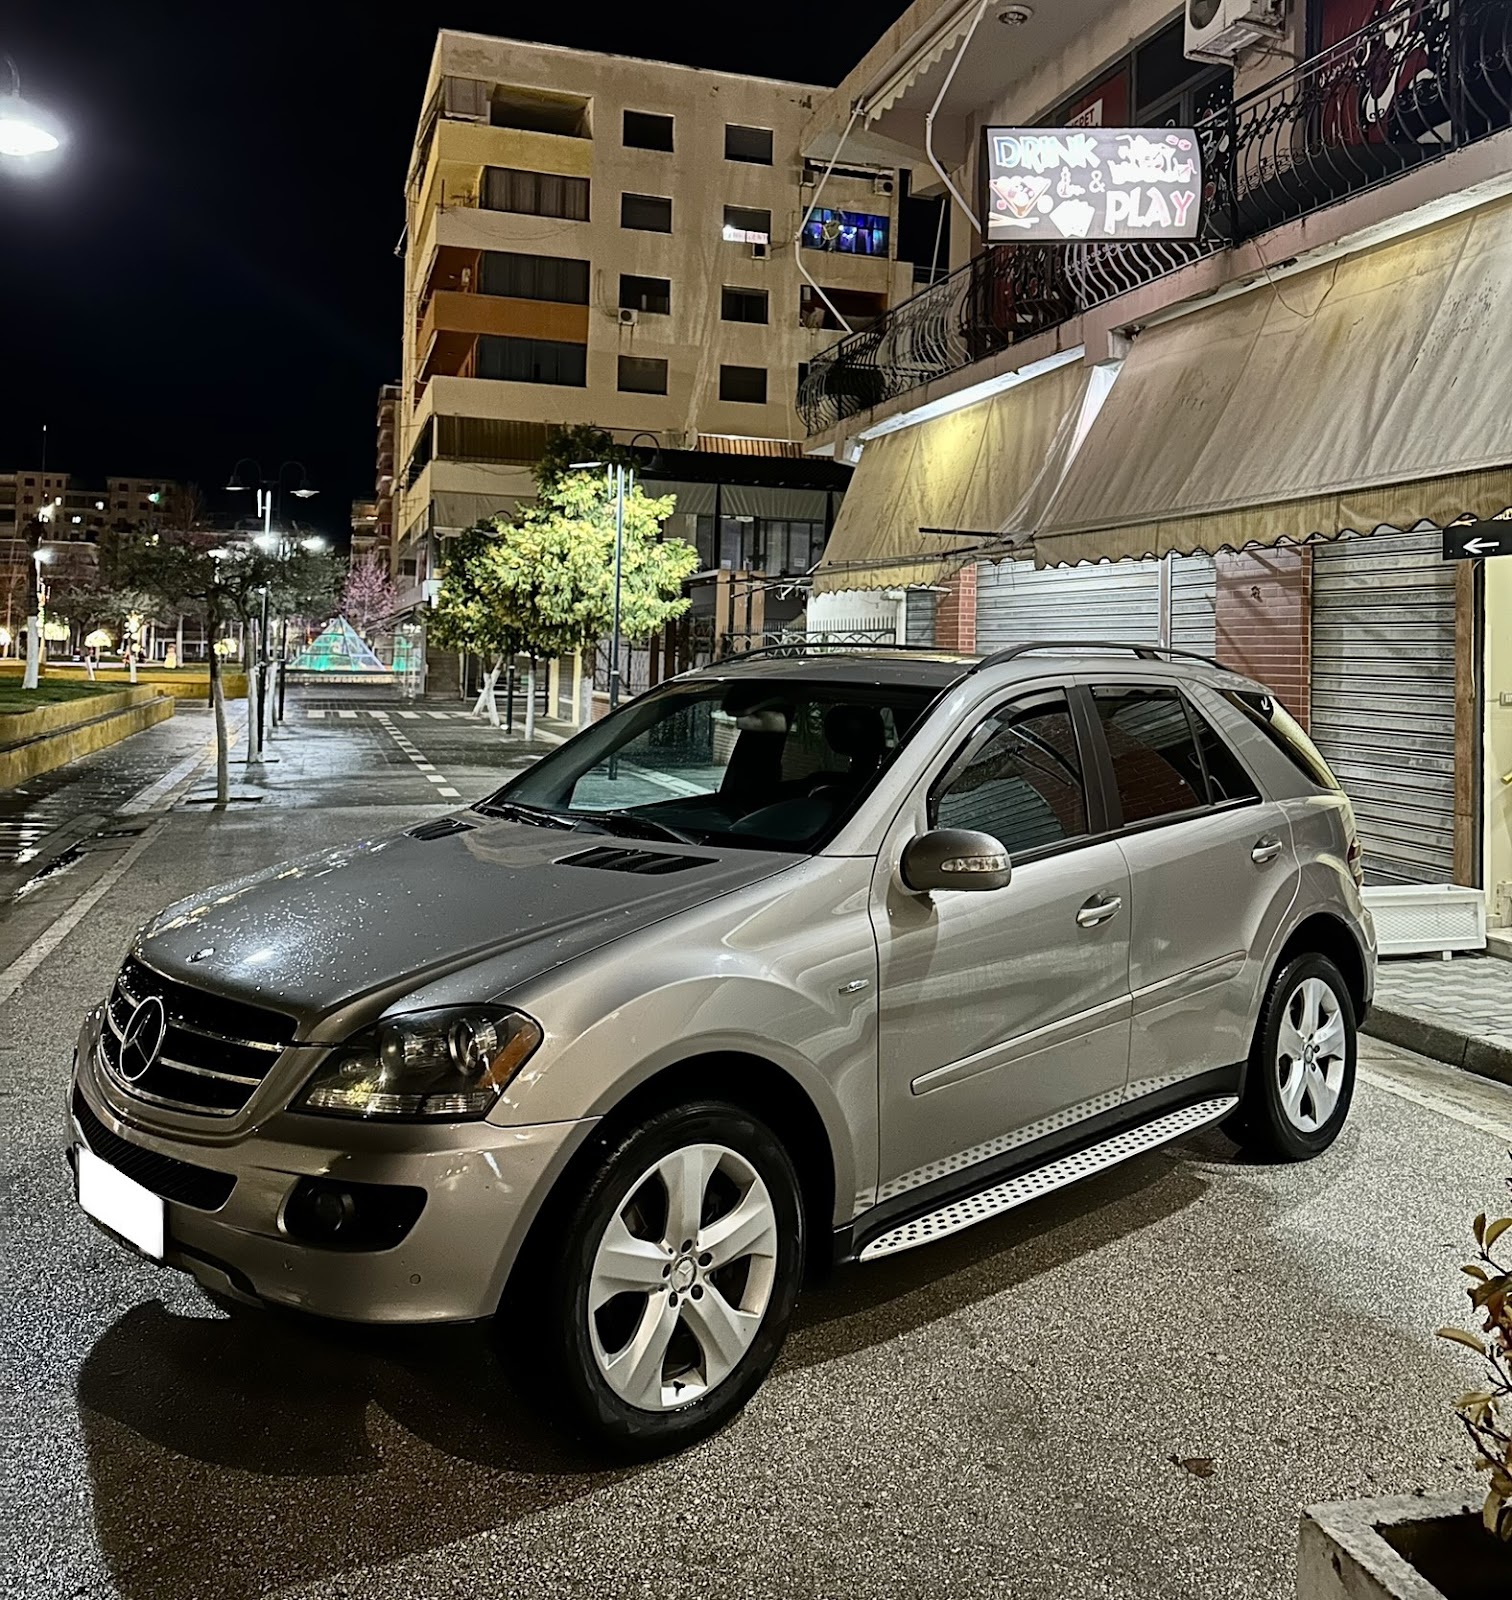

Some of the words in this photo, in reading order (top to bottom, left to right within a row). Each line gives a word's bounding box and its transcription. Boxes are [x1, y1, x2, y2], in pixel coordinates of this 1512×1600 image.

[994, 134, 1100, 173] DRINK
[1089, 169, 1106, 193] &
[1104, 187, 1195, 234] PLAY
